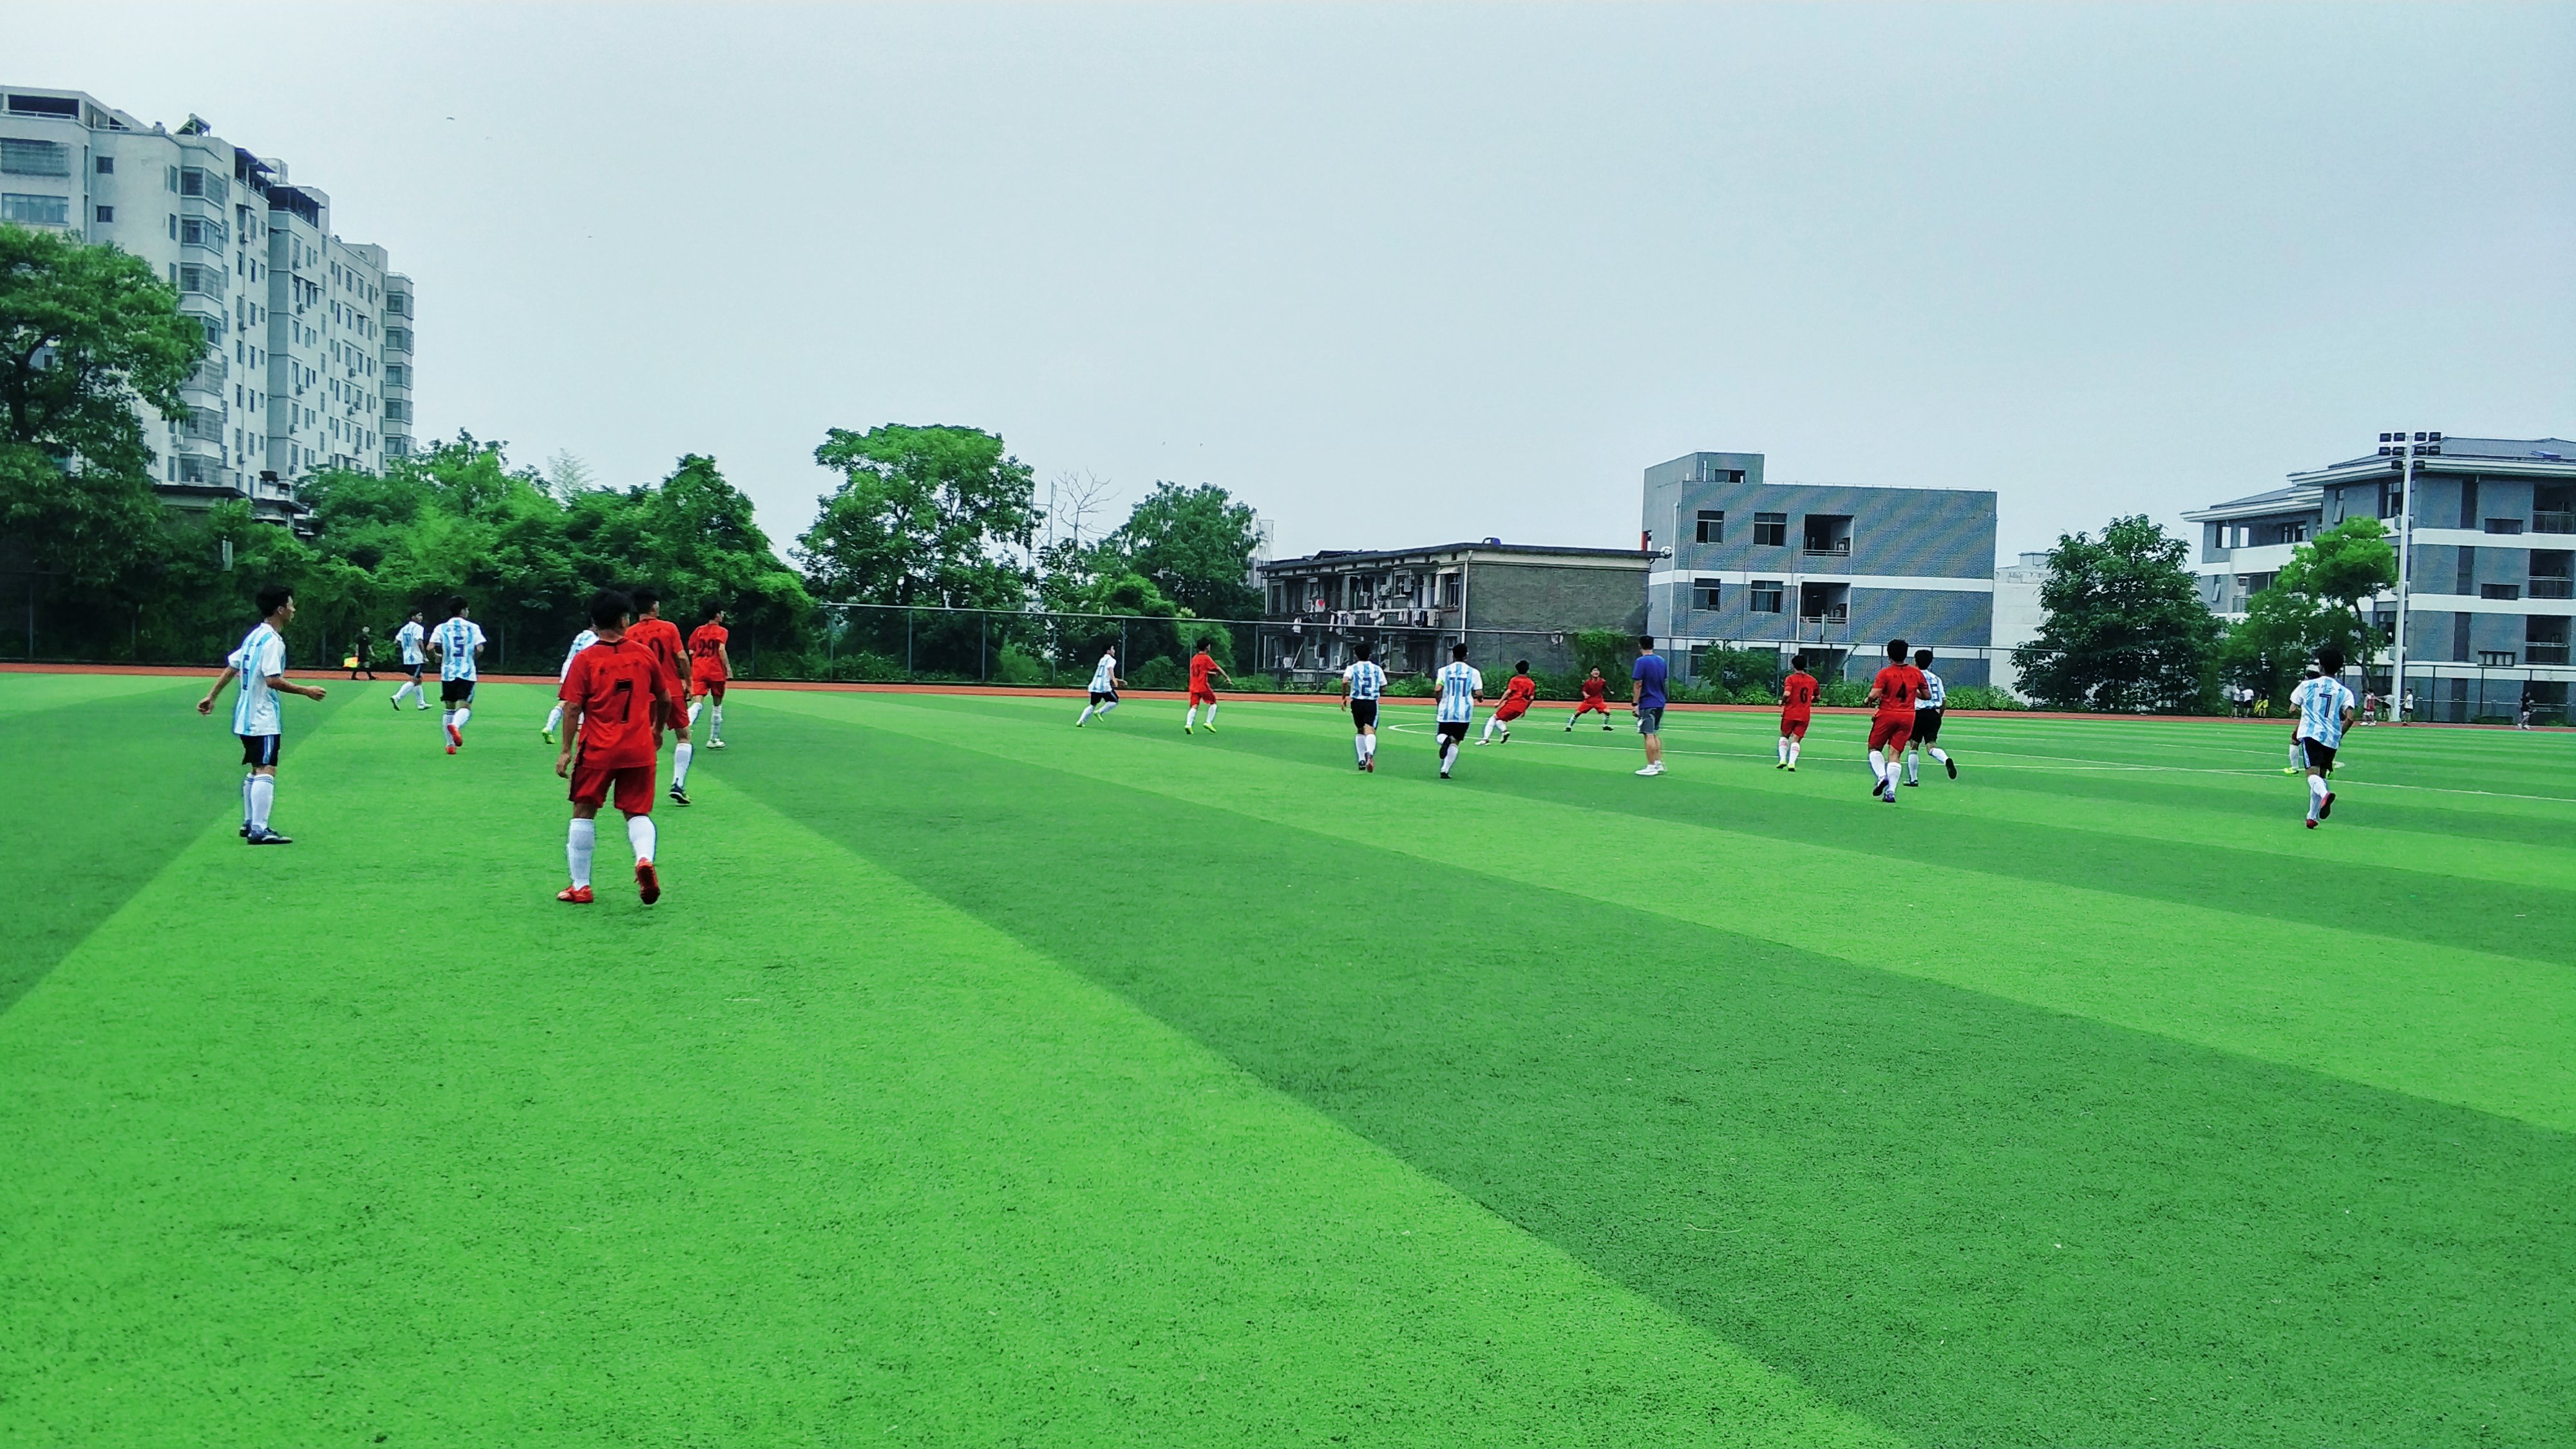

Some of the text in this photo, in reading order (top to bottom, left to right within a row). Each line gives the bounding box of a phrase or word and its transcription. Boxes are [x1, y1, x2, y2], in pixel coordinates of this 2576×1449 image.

[453, 636, 464, 657] 5
[1361, 677, 1372, 696] 2
[1449, 677, 1467, 697] 17
[1800, 687, 1808, 704] 6
[1896, 681, 1908, 703] 4
[616, 678, 633, 724] 7
[2319, 693, 2332, 717] 7
